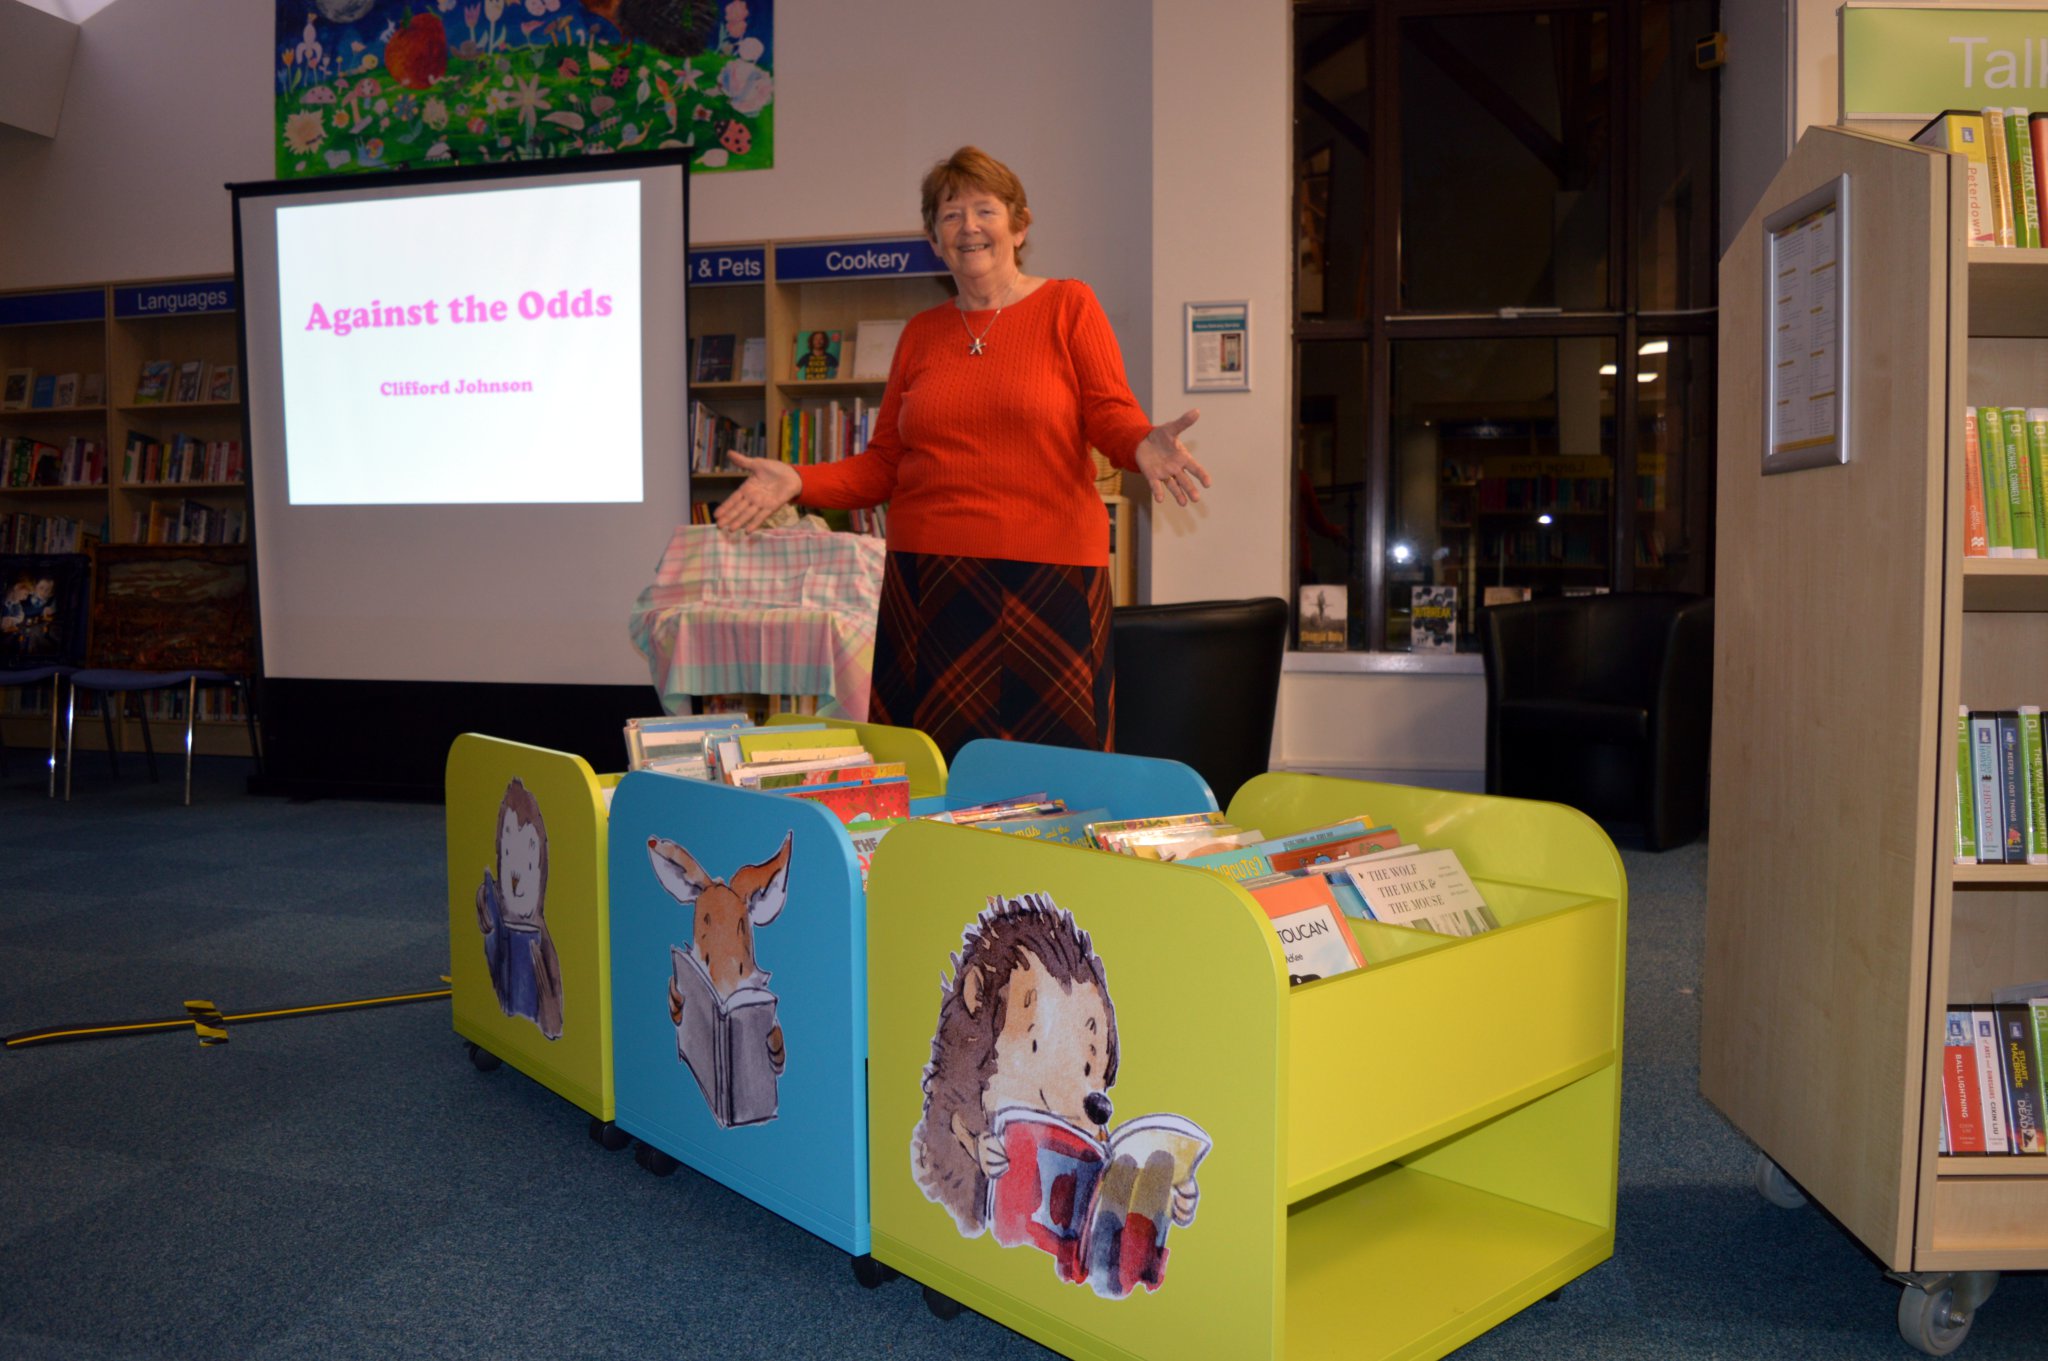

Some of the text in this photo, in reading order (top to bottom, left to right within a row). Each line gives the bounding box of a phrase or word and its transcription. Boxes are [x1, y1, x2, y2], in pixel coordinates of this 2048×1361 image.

[2023, 155, 2035, 191] DARK
[1968, 168, 1981, 235] Peterdown
[2026, 196, 2039, 229] LAKE
[698, 259, 712, 278] &
[718, 257, 762, 277] Pets
[826, 250, 910, 272] Cookery
[138, 290, 228, 313] Languages
[304, 288, 613, 336] Against the Odds
[380, 378, 533, 397] Clifford Johnson
[2006, 444, 2020, 504] MICHAEL CONNELLY
[1983, 790, 1993, 829] HISTORY
[2034, 747, 2047, 849] THE WILD LAUGHTER
[1367, 863, 1417, 882] THE WOLF
[1378, 878, 1437, 898] THE DUCK &
[1388, 894, 1445, 915] THE MOUSE
[1276, 919, 1329, 945] TOUCAN
[1955, 1054, 1964, 1074] BALL
[2010, 1042, 2023, 1088] MACBRIDE
[2019, 1050, 2028, 1080] STUART
[1957, 1076, 1968, 1118] LIGHTNING
[2017, 1100, 2027, 1128] DEAD
